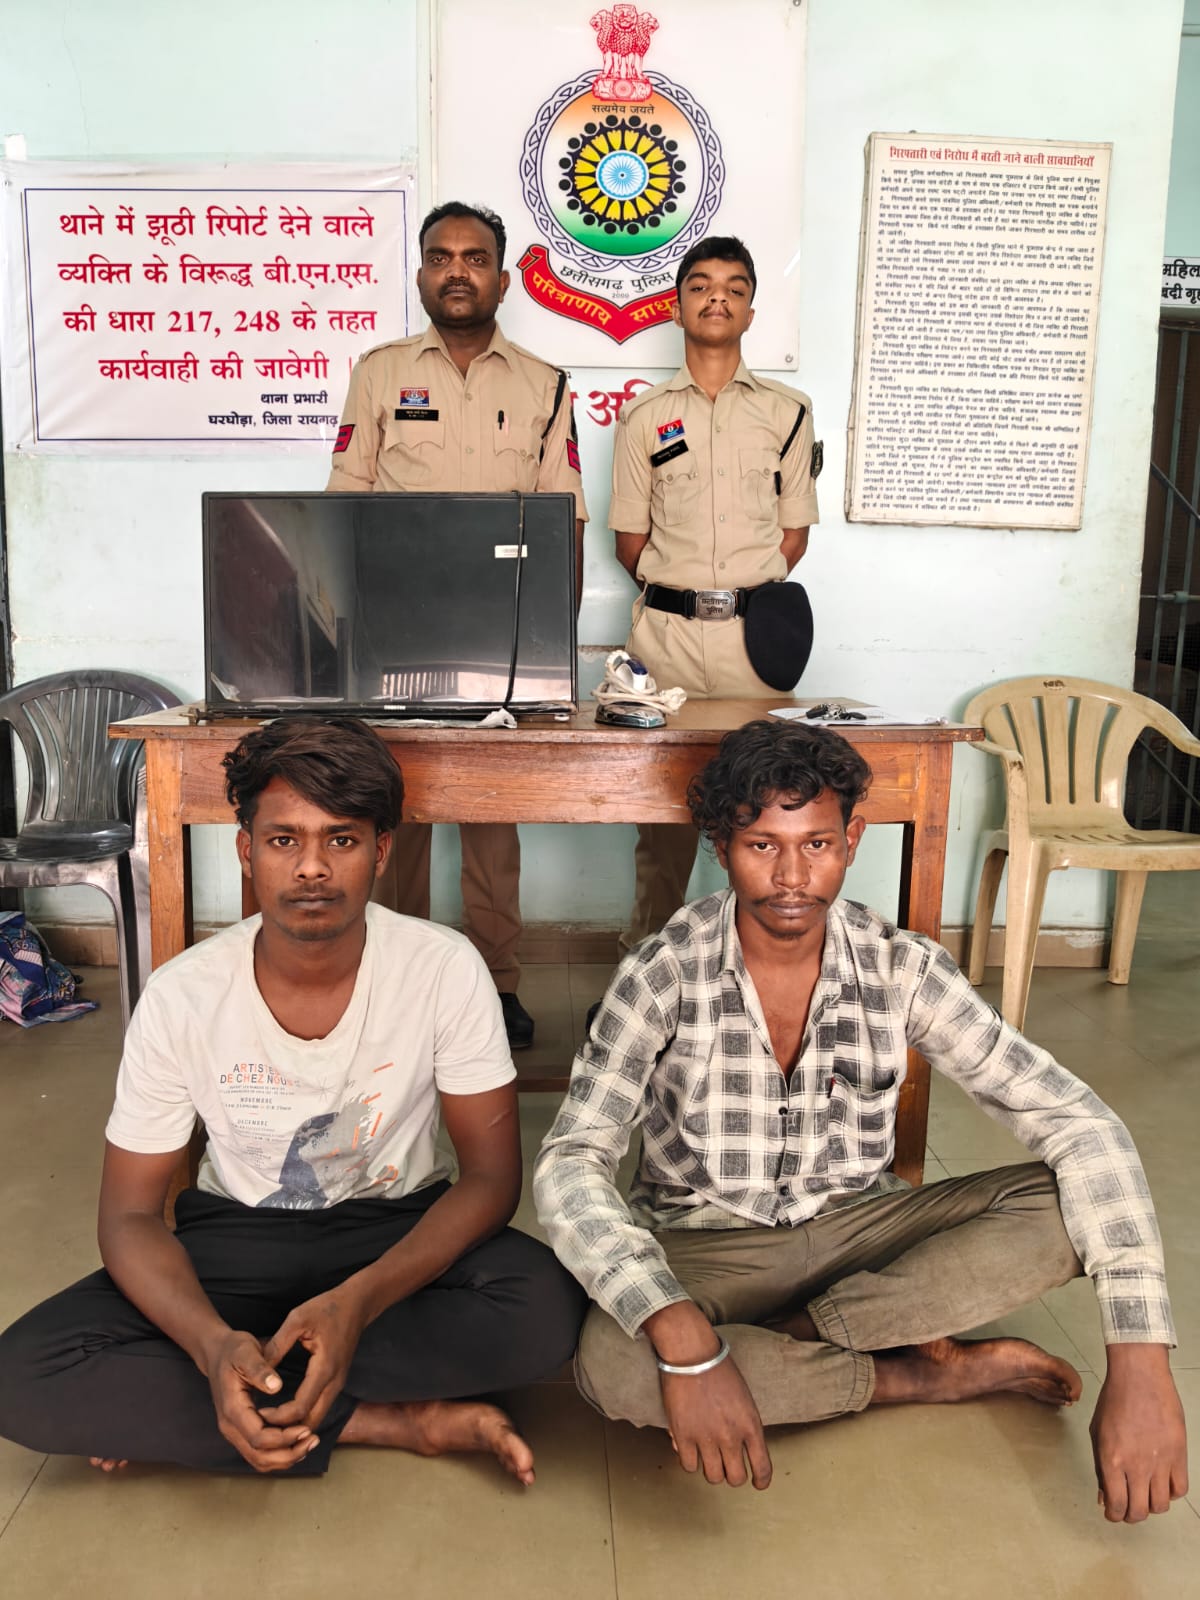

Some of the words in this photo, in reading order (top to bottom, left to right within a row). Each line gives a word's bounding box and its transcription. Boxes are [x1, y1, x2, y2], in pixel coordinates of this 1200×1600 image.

[592, 103, 626, 114] सत्यमेव
[630, 103, 655, 114] जयते
[1003, 152, 1021, 163] जाने
[60, 205, 104, 235] थाने
[115, 205, 134, 235] में
[146, 207, 195, 245] झूठी
[206, 206, 267, 236] रिपोर्ट
[278, 206, 312, 237] देने
[323, 208, 374, 237] वाले
[58, 254, 132, 284] व्यक्ति
[142, 255, 168, 283] के
[263, 256, 377, 289] बी.एन.एस.
[630, 271, 674, 293] पुलिस
[532, 271, 612, 326] परित्राणाय
[63, 304, 96, 331] की
[108, 312, 154, 332] धारा
[168, 311, 220, 336] 217,
[235, 310, 280, 332] 248
[291, 302, 316, 330] के
[328, 310, 376, 333] तहत
[98, 350, 199, 382] कार्यवाही
[209, 351, 243, 379] की
[254, 350, 329, 379] जावेगी
[261, 393, 288, 404] थाना
[293, 390, 328, 404] प्रभारी
[263, 411, 292, 425] जिला
[220, 1074, 233, 1084] DE
[236, 1074, 264, 1083] CHEZ
